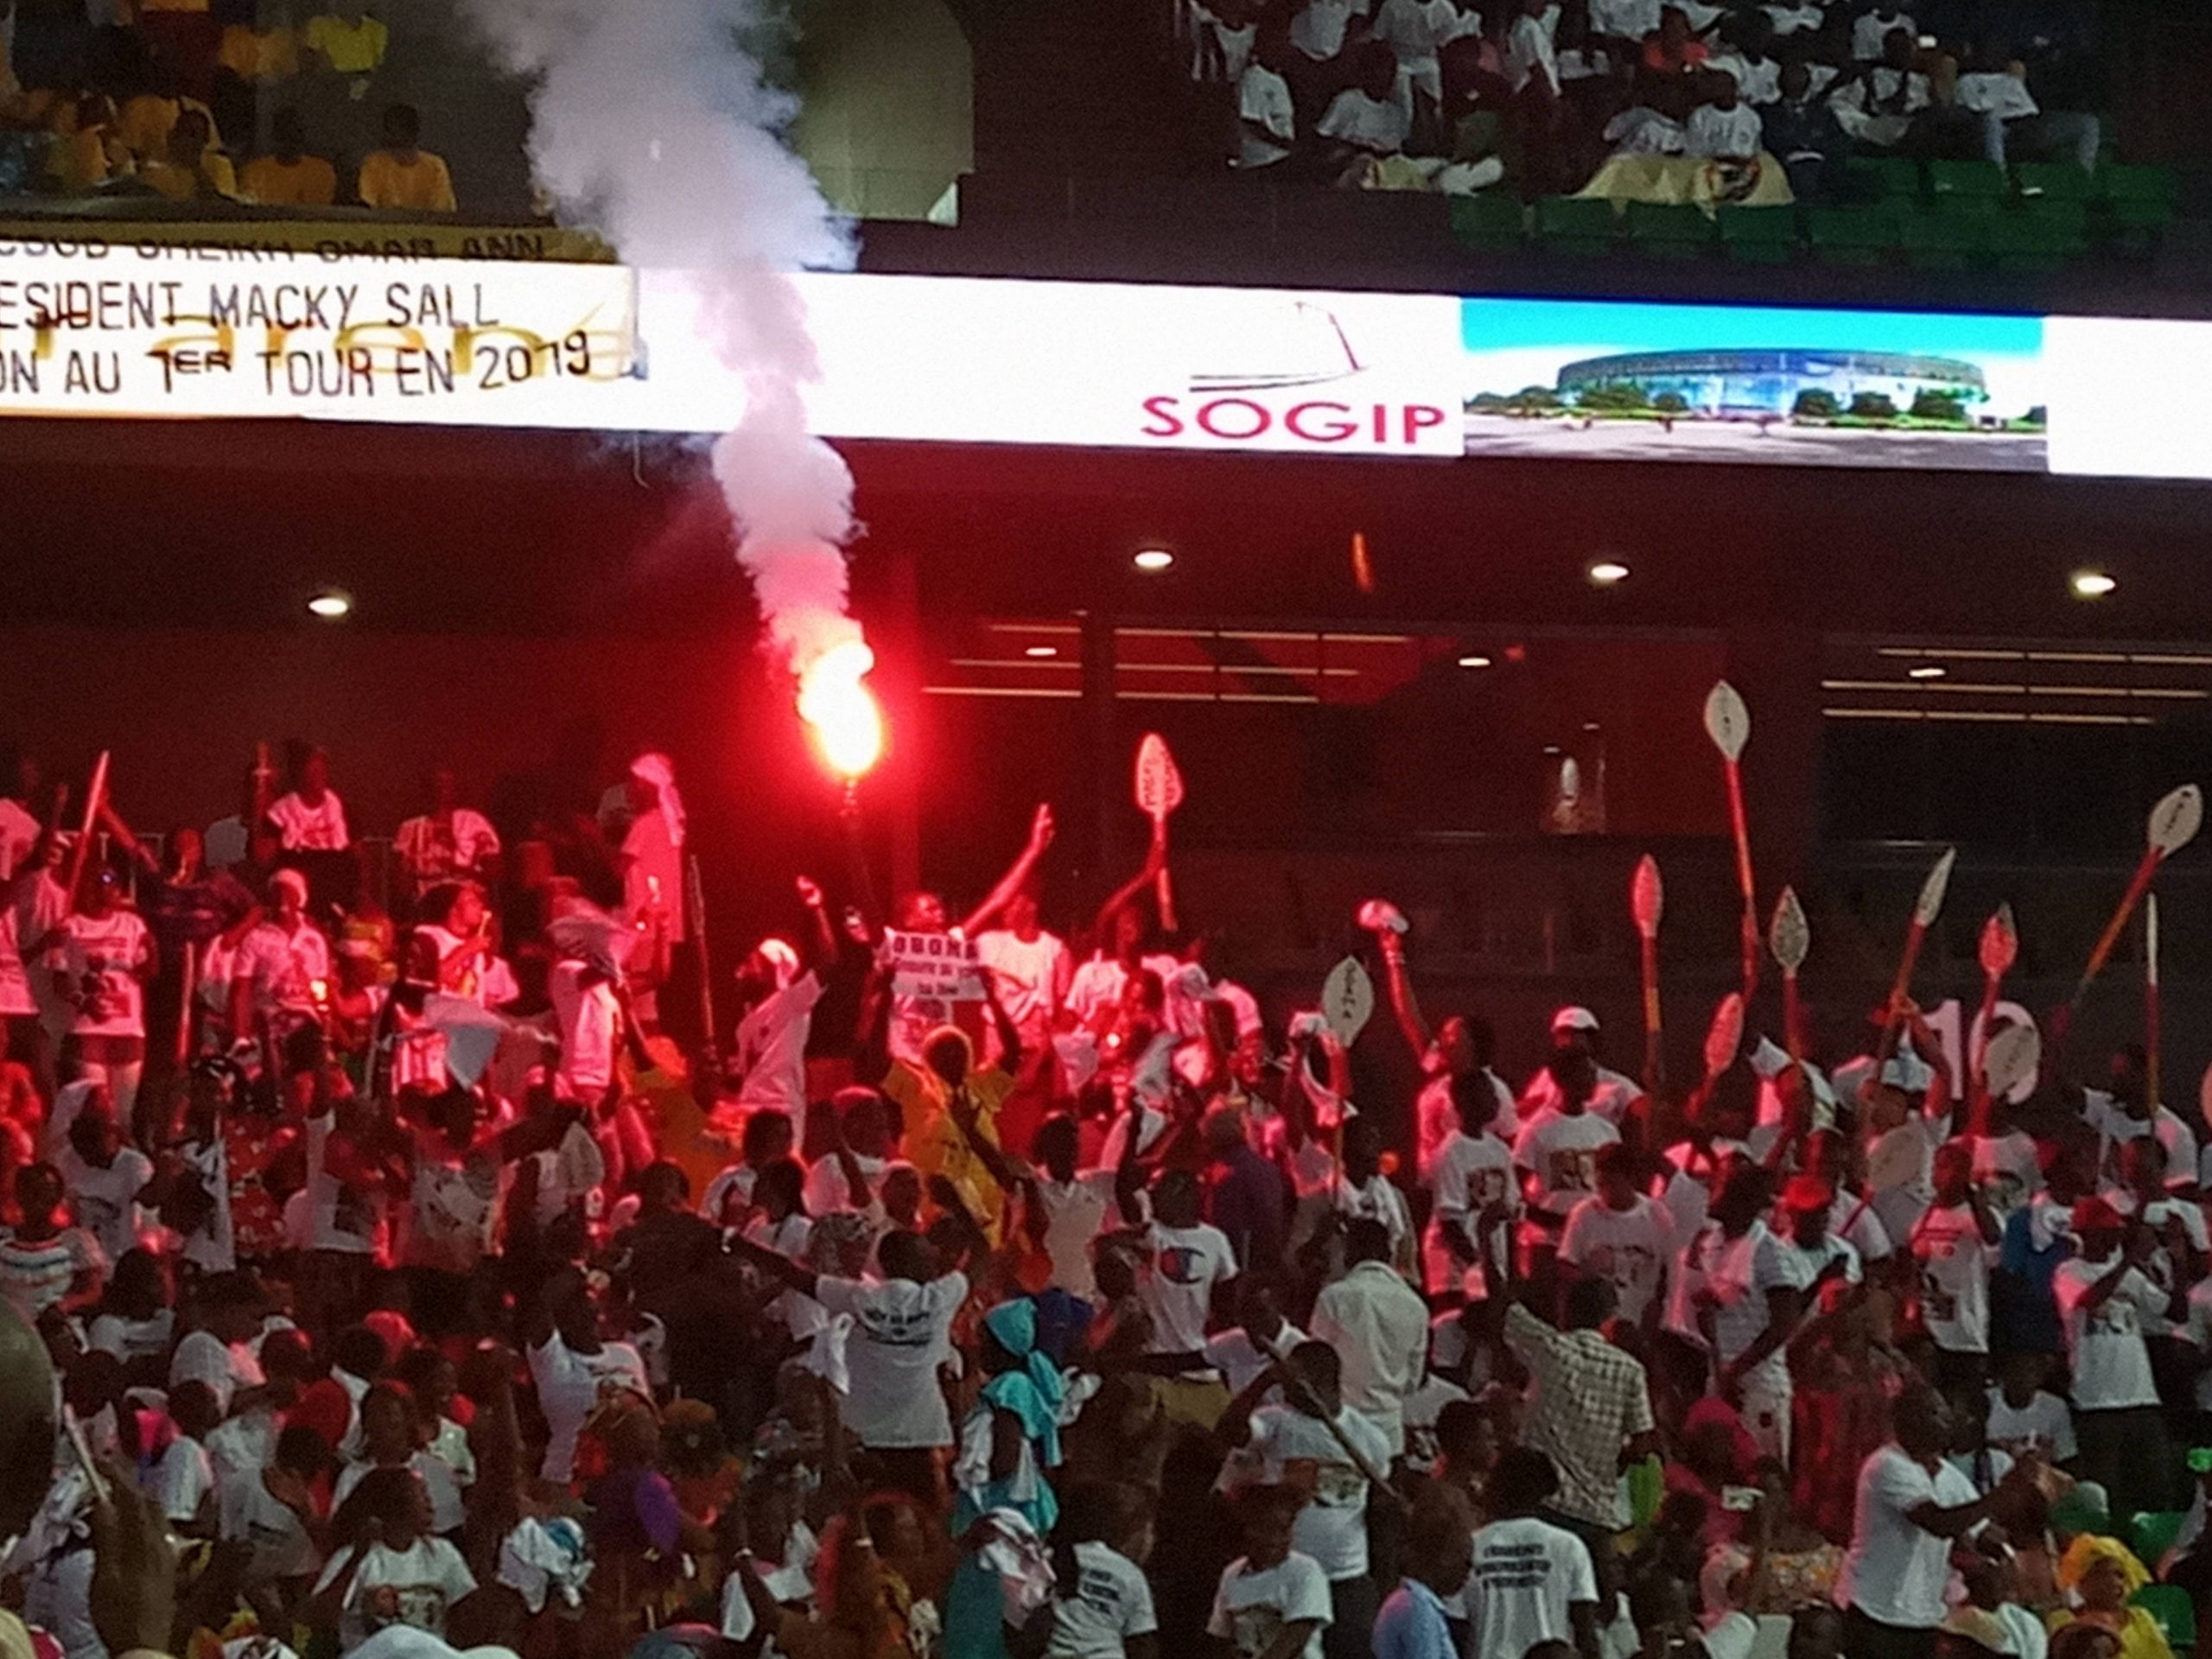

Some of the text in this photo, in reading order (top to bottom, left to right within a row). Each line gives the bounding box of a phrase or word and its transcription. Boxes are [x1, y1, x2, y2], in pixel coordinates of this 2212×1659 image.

[210, 282, 358, 332] MACKY
[385, 282, 499, 330] SALL
[0, 349, 40, 394] N
[64, 349, 121, 395] AU
[257, 346, 374, 397] TOUR
[396, 346, 454, 397] EN
[475, 329, 590, 391] 2019
[1140, 394, 1446, 445] SOGIP
